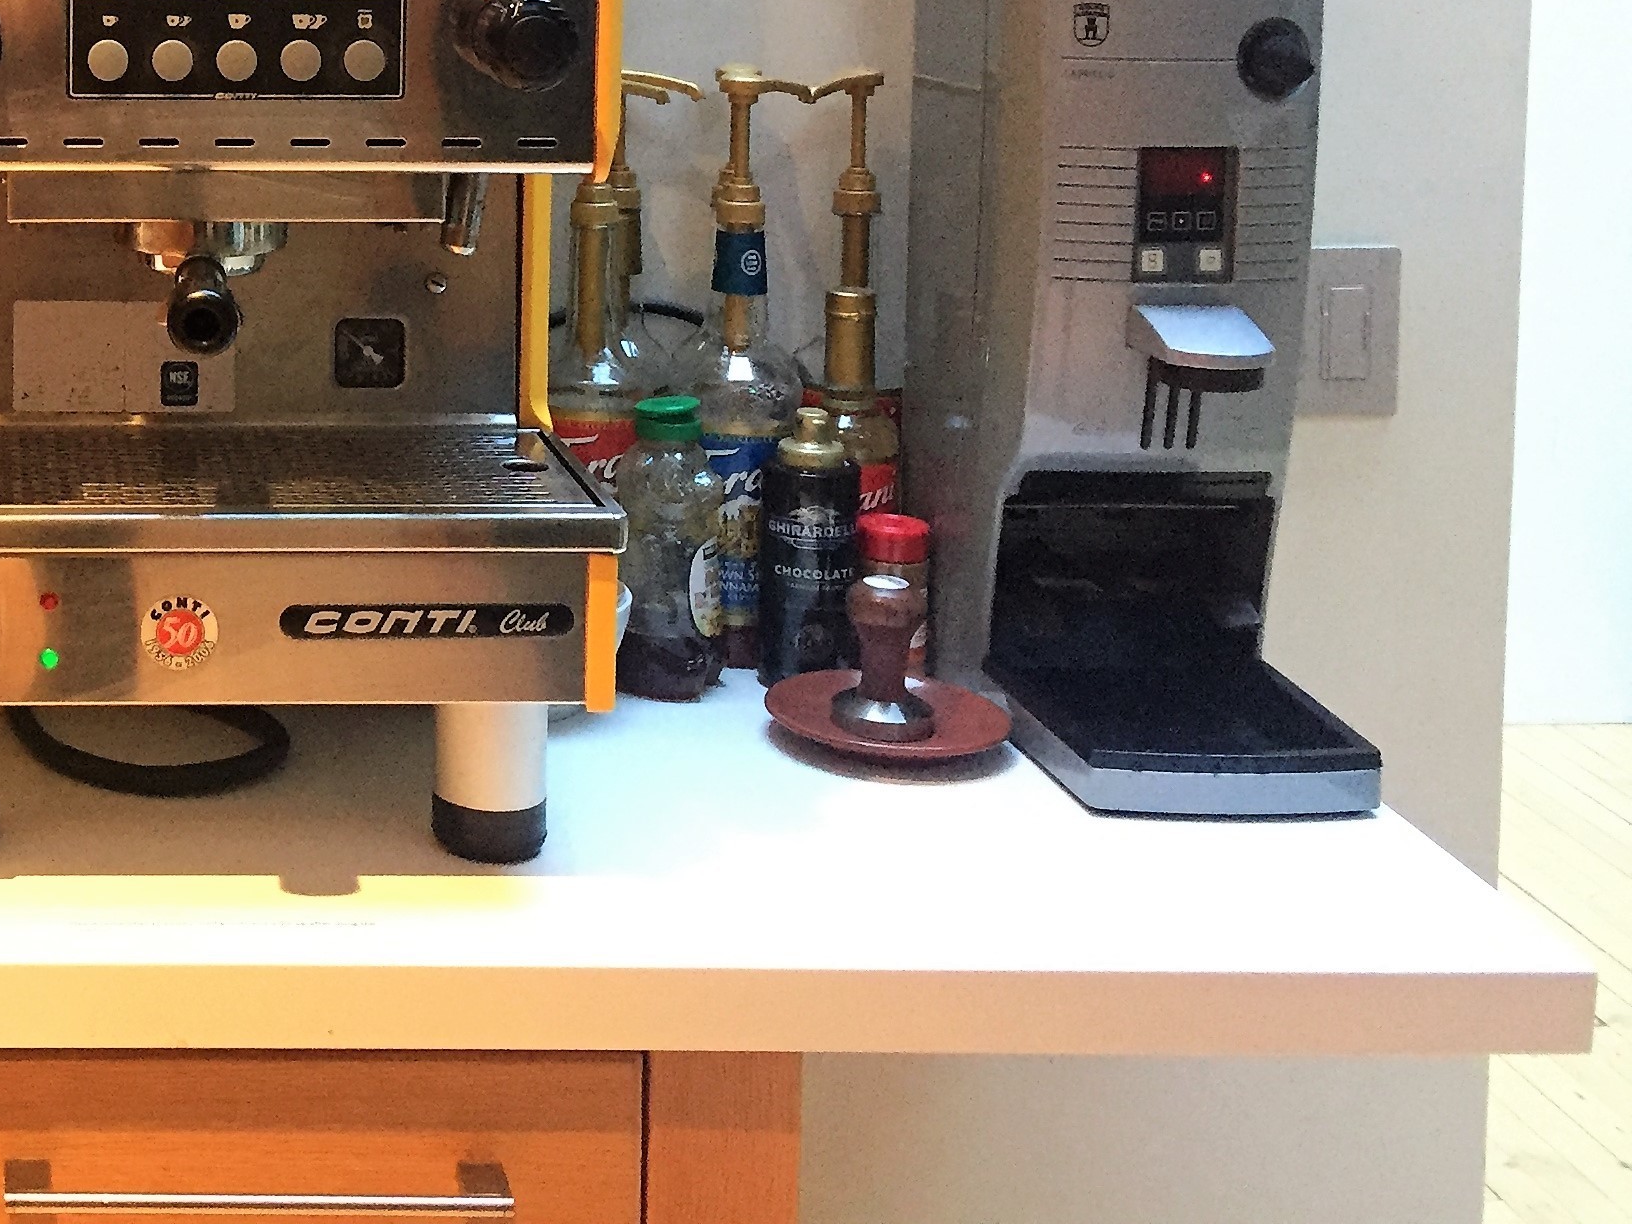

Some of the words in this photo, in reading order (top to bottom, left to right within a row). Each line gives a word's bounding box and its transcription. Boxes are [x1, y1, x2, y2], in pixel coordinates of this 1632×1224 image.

[169, 371, 189, 384] NSF
[150, 596, 211, 621] CONTI
[162, 616, 198, 649] 50
[304, 609, 476, 634] CONTI
[499, 609, 548, 633] Club
